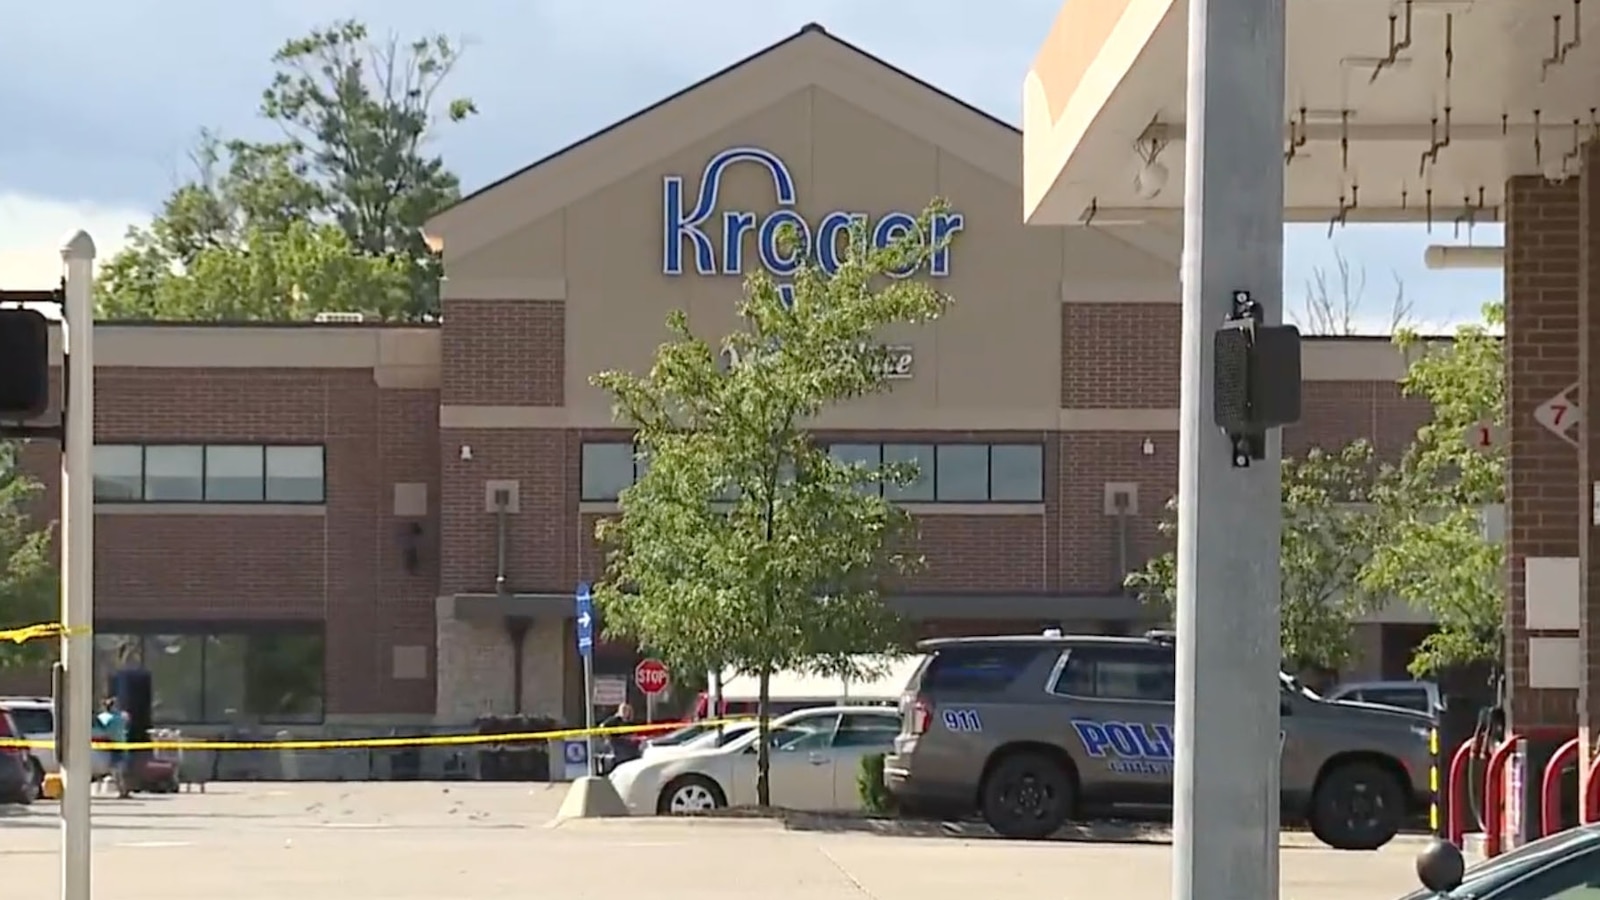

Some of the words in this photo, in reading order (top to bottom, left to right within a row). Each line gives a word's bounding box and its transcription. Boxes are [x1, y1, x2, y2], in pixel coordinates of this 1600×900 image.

[663, 147, 964, 311] Kroger
[1550, 405, 1567, 425] 7
[1480, 427, 1491, 446] 1
[638, 669, 666, 685] STOP
[943, 709, 982, 731] 911
